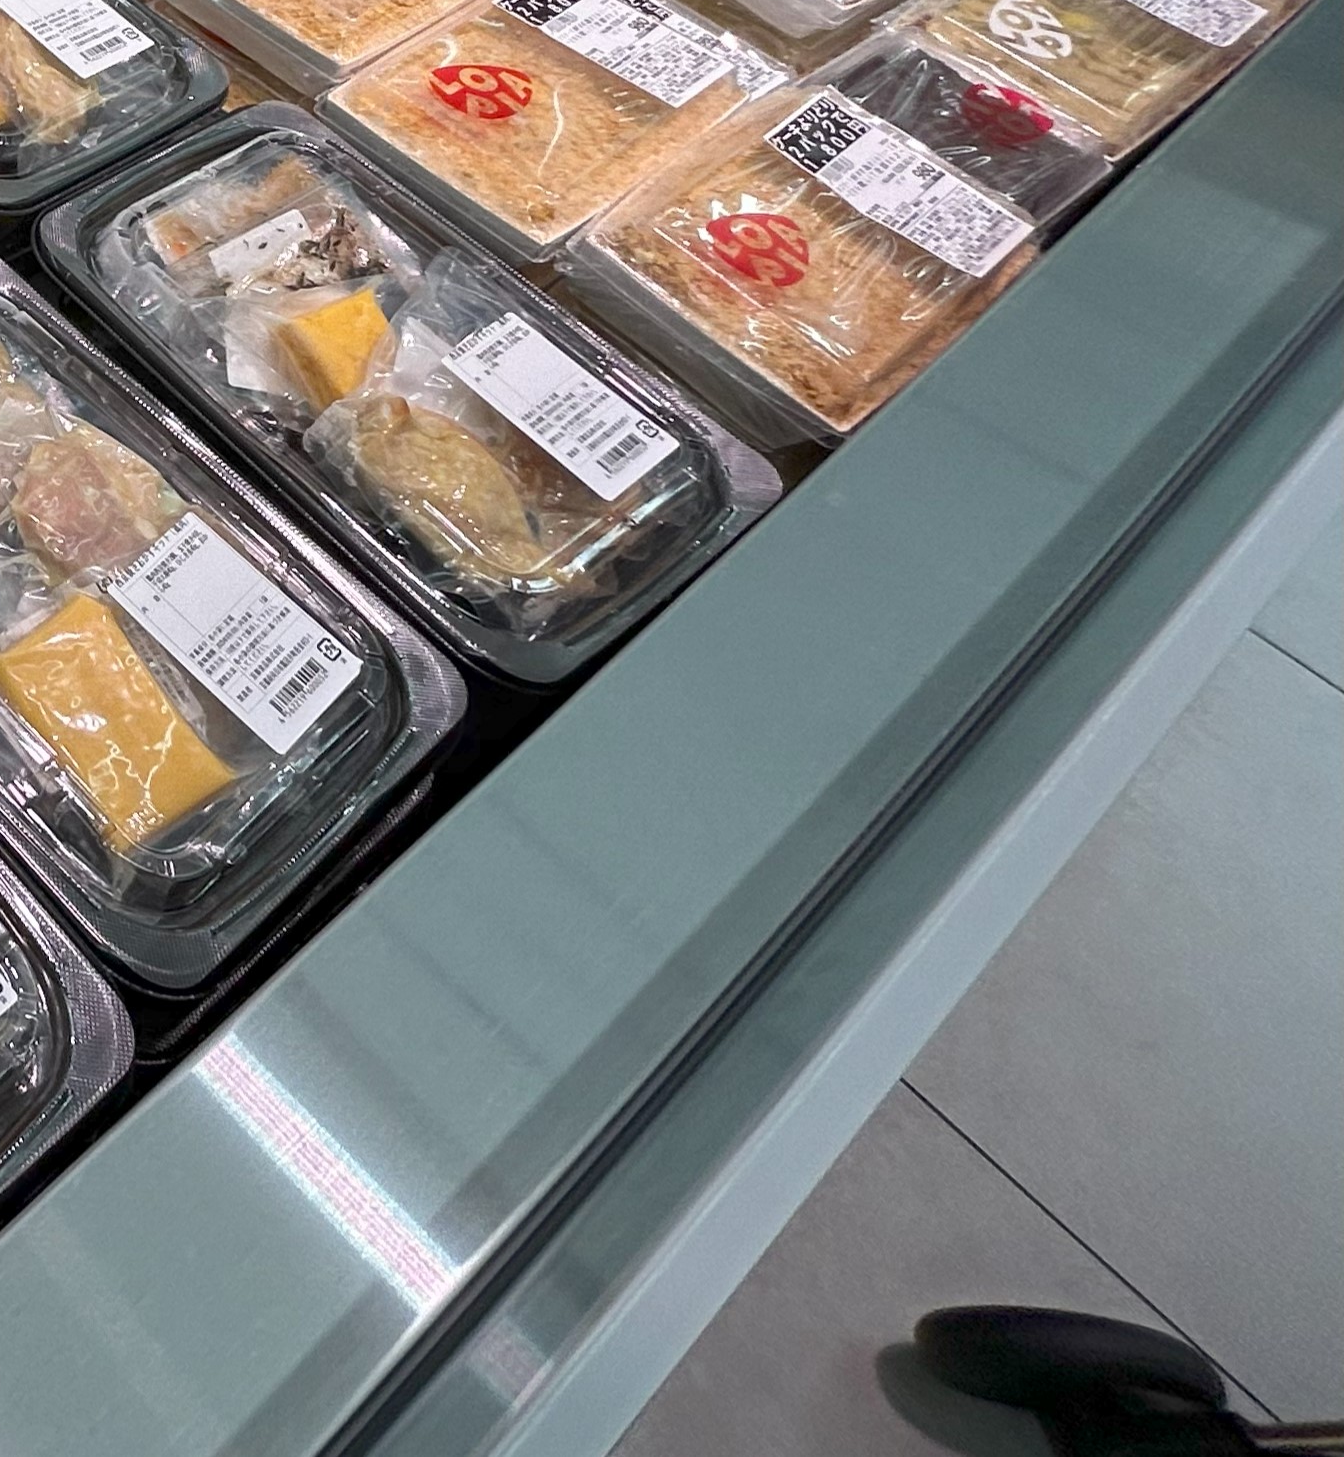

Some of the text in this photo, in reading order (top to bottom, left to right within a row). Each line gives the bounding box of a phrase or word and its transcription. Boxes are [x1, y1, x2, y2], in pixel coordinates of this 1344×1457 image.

[766, 97, 840, 150] ケーキよりどり
[784, 110, 854, 158] 2パックで
